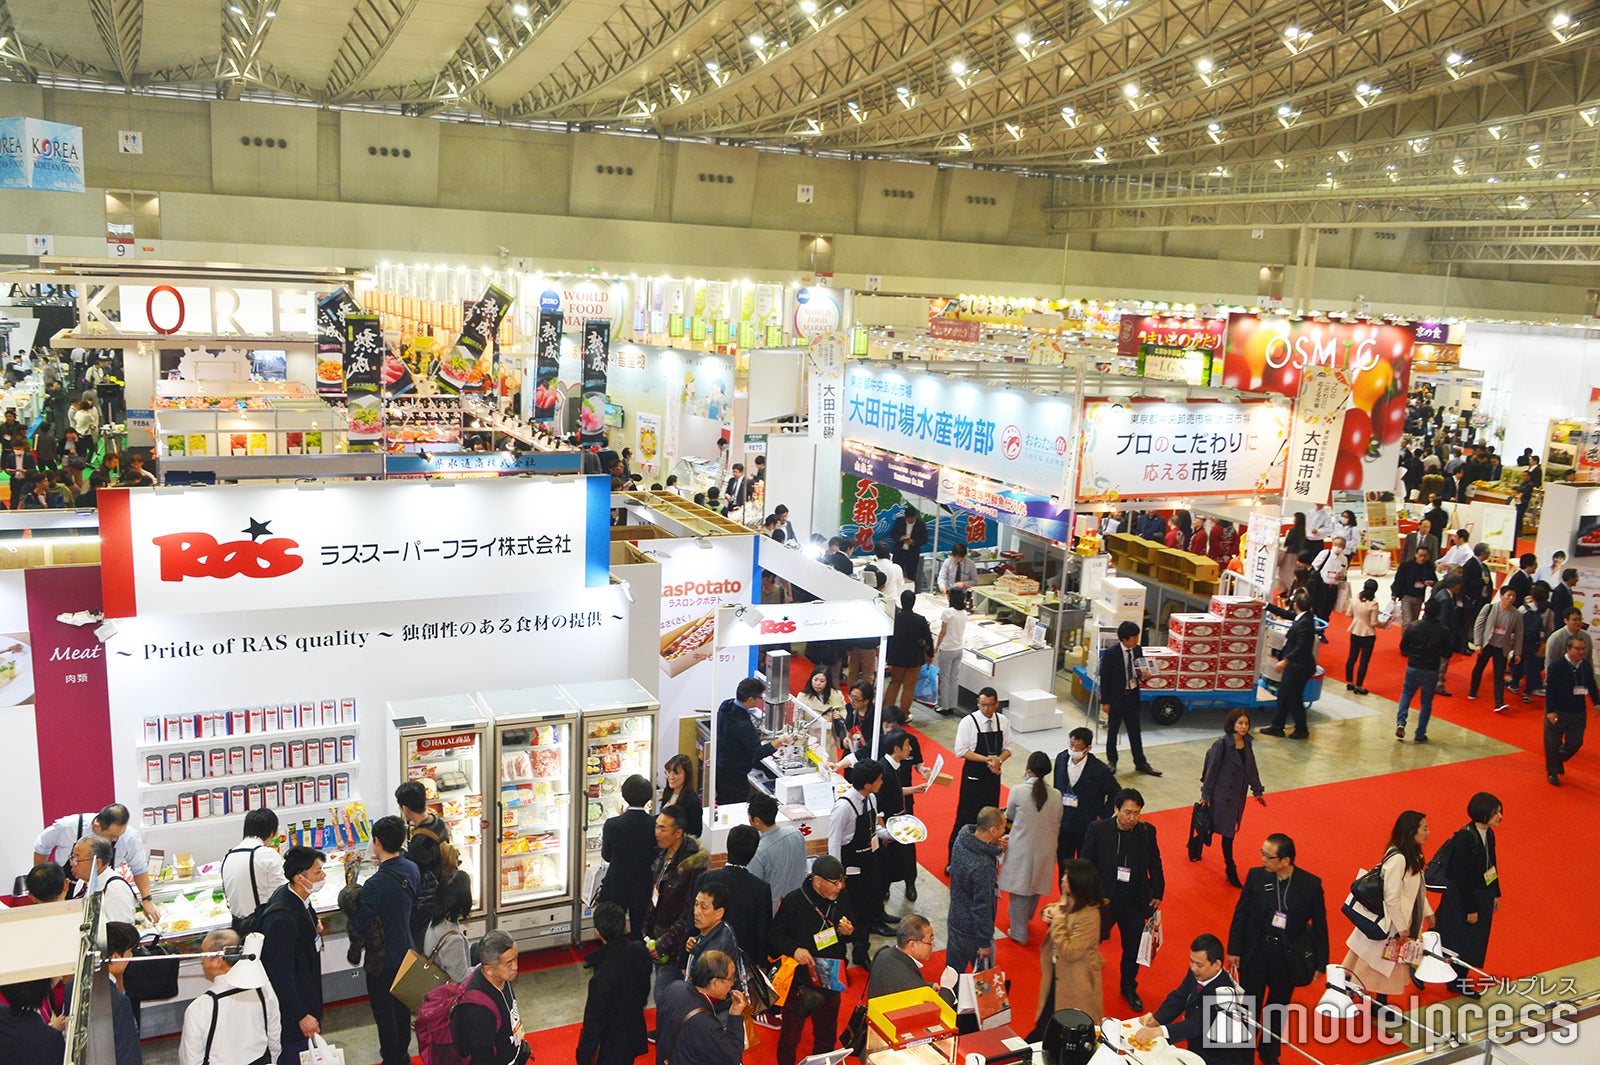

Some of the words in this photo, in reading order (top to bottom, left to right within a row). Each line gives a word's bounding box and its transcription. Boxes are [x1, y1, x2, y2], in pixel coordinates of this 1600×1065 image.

[0, 137, 23, 153] REA
[32, 137, 79, 160] KOREA
[62, 163, 80, 174] FOOD
[116, 244, 126, 256] 9
[564, 290, 609, 302] WORLD
[569, 304, 603, 314] FOOD
[1265, 335, 1381, 371] OSMIC
[823, 384, 836, 439] 大田市場
[848, 393, 997, 456] 大田市場水産物部
[1116, 432, 1259, 456] プロのこだわりに
[1143, 460, 1229, 483] 応える市場
[1294, 430, 1321, 496] 大田市場
[661, 579, 742, 598] asPotato
[144, 641, 204, 660] Pride
[212, 637, 236, 656] of
[242, 634, 288, 653] RAS
[295, 629, 369, 653] quality
[402, 611, 602, 642] 独創性のある食材の提供
[49, 644, 102, 661] Meat
[65, 673, 88, 684] 肉類
